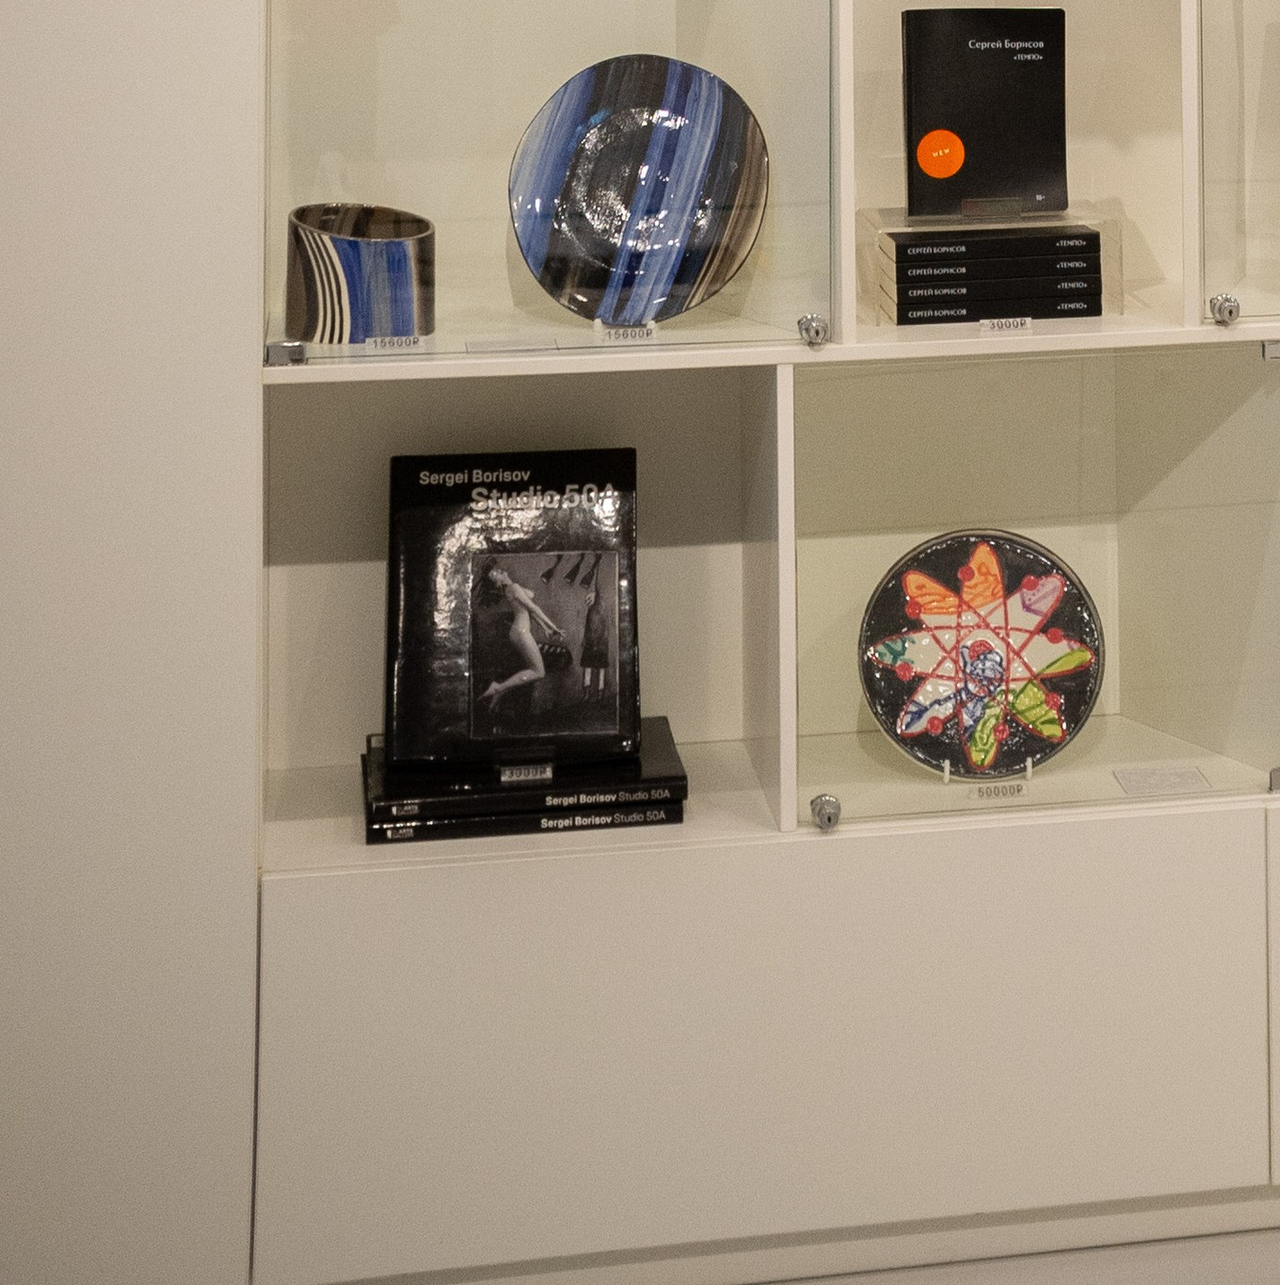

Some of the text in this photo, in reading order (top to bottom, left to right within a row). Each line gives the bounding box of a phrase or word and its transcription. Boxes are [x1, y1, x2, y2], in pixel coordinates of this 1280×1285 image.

[968, 39, 1044, 50] Сергей Борисов
[419, 468, 531, 486] Sergei Borisov
[470, 485, 558, 511] Studio
[545, 789, 670, 807] Sergei Borisov Studio 50A
[541, 811, 666, 829] Sergei Borisov Studio 50A
